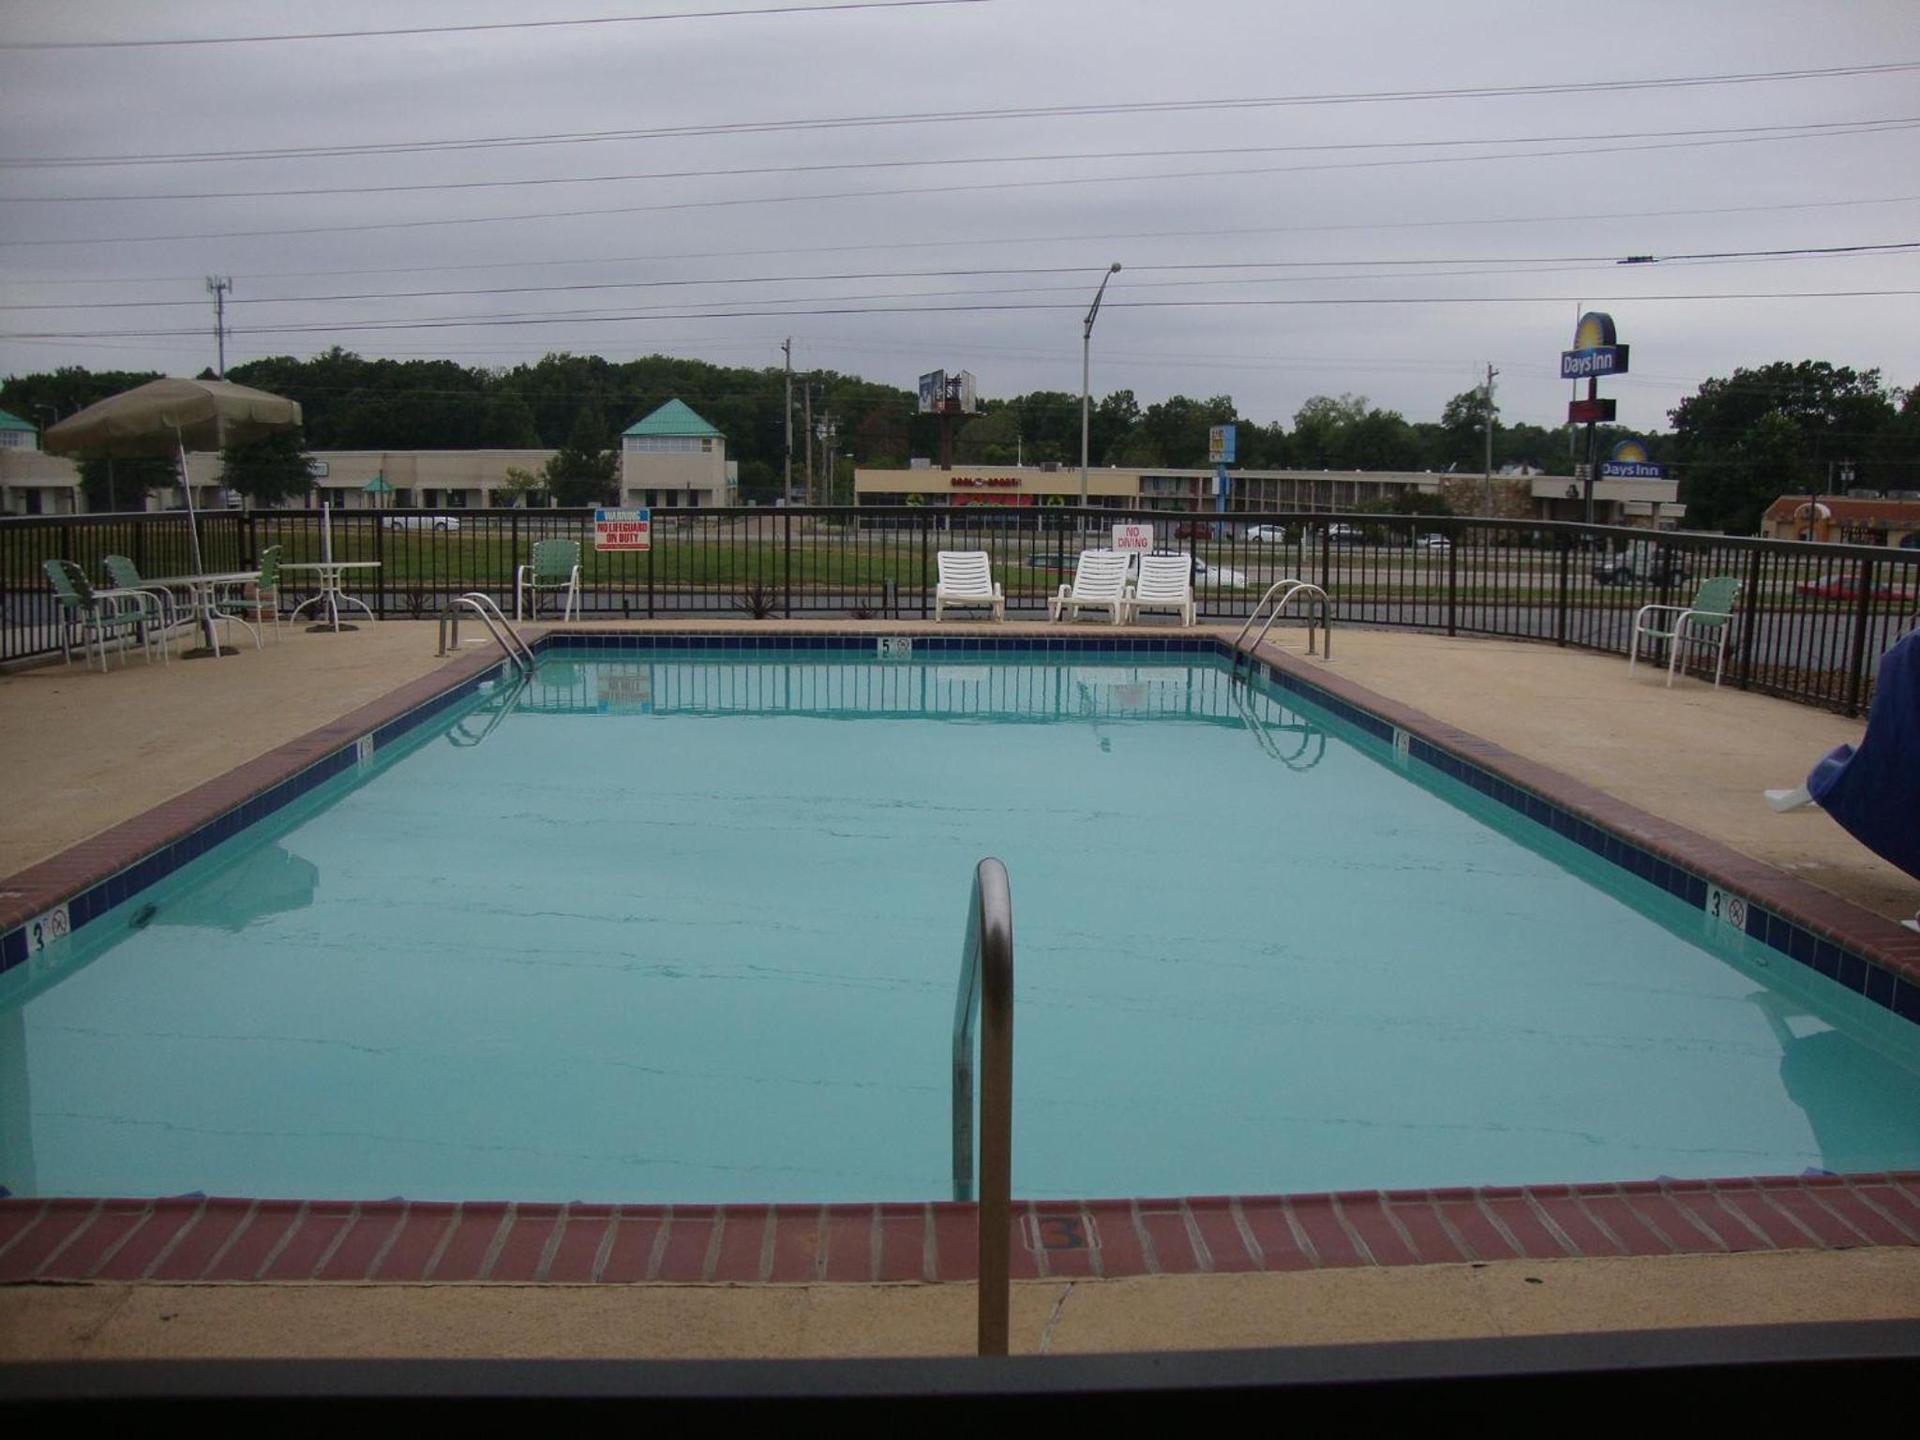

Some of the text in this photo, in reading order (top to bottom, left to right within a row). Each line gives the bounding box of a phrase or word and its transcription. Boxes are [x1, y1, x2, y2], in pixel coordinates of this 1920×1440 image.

[1563, 352, 1613, 375] Days Inn
[1602, 462, 1634, 477] Days
[1636, 463, 1659, 476] Inn
[597, 522, 648, 532] NO LIFEGUARD
[1126, 527, 1139, 537] NO
[607, 533, 639, 543] ON DUTY
[1118, 537, 1147, 547] DIVING
[882, 638, 890, 655] 5
[1711, 890, 1721, 918] 3
[33, 922, 45, 952] 3
[1040, 1215, 1084, 1249] 3
